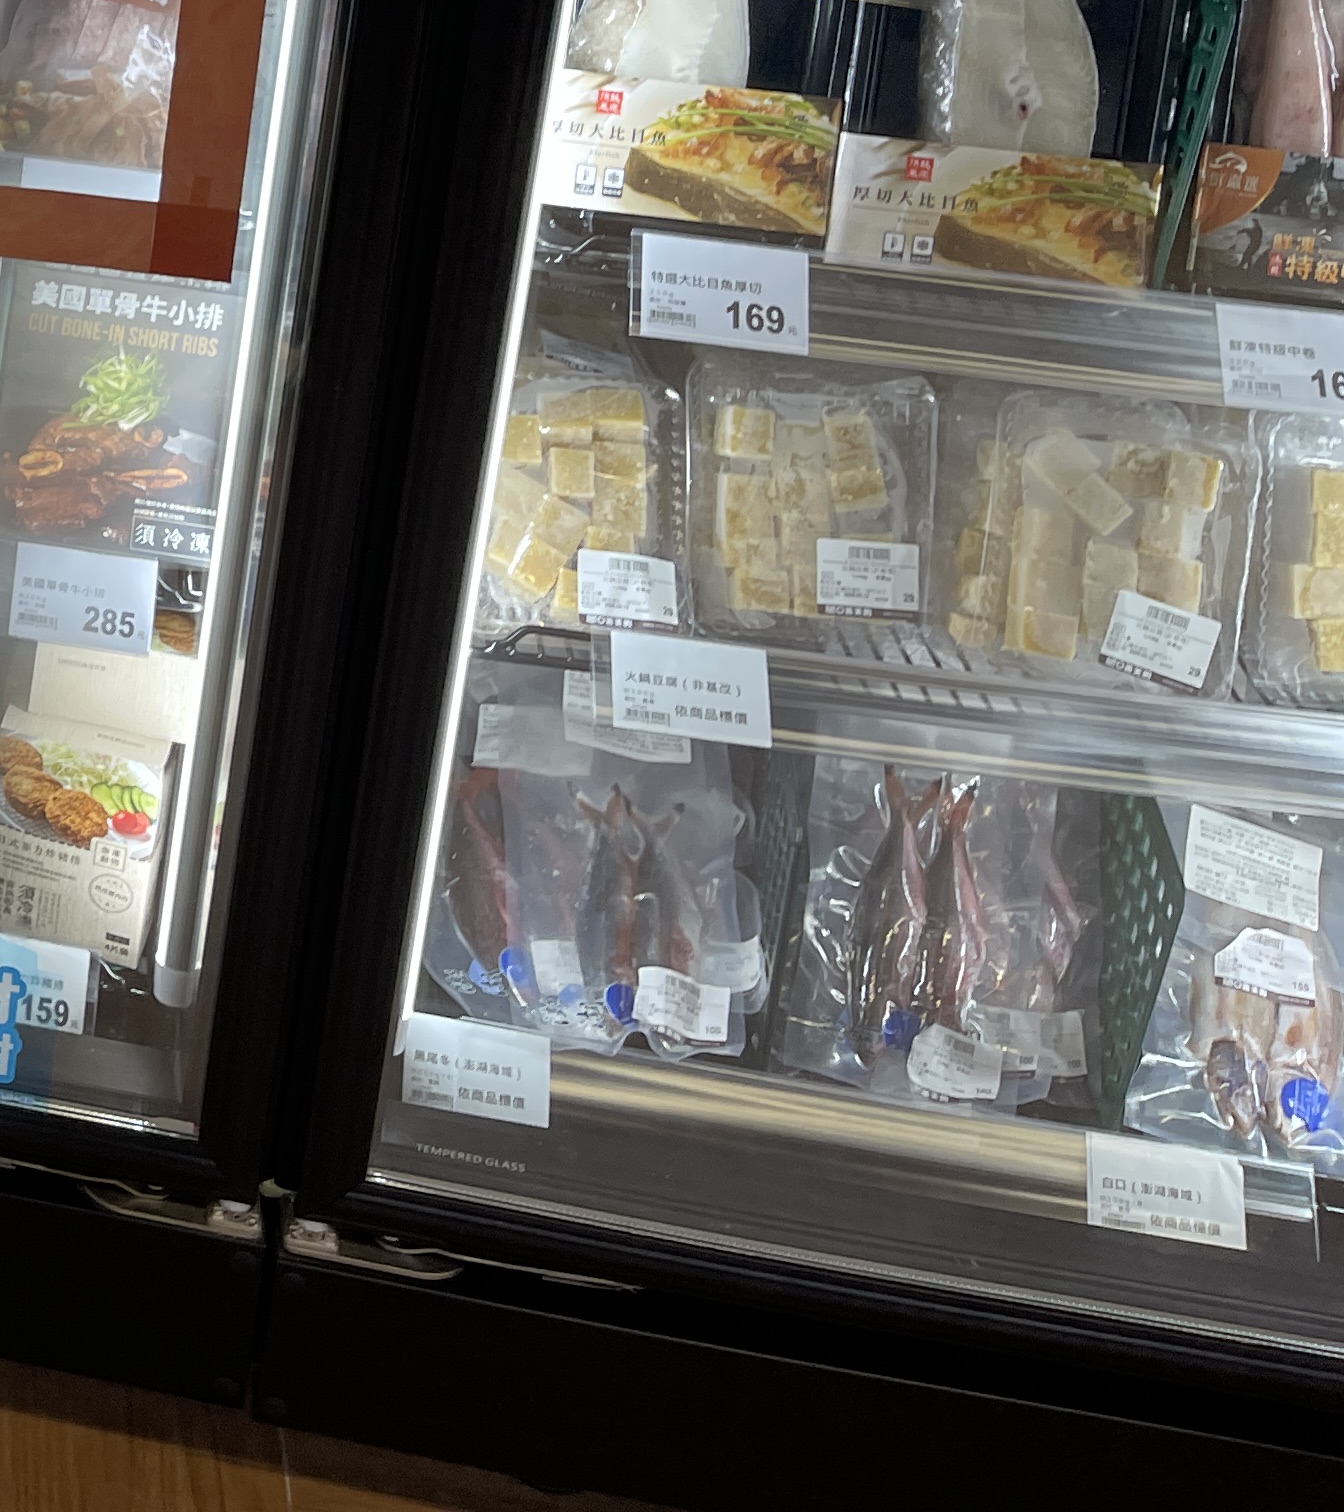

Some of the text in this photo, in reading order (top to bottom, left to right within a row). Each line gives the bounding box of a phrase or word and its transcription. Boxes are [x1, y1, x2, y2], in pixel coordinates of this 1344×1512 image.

[1285, 256, 1344, 284] 特級
[31, 278, 224, 333] 美國單骨牛小排
[724, 300, 786, 335] 169
[27, 311, 60, 334] CUT
[126, 323, 182, 352] SHORT
[182, 333, 220, 359] RIBS
[133, 521, 213, 556] 須冷凍
[81, 605, 137, 640] 285
[19, 993, 70, 1027] 159
[415, 1142, 527, 1175] TEMPERED GLASS
